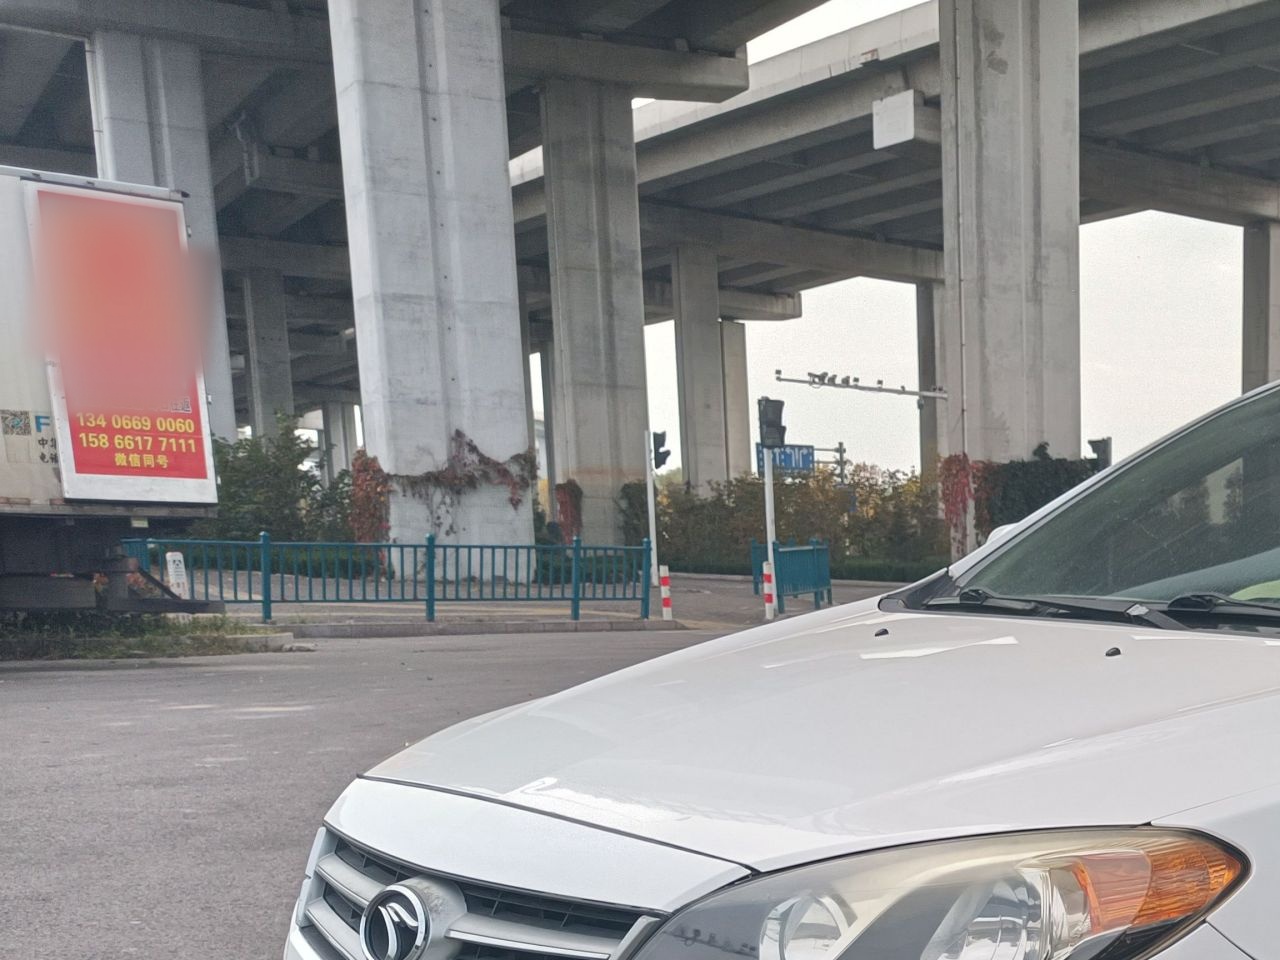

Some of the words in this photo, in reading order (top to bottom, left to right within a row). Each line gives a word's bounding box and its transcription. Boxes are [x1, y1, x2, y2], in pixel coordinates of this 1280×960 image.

[77, 413, 107, 428] 134
[112, 415, 151, 430] 0669
[157, 417, 195, 432] 0060
[80, 433, 109, 448] 158
[114, 435, 153, 450] 6617
[158, 437, 196, 453] 7111
[115, 453, 168, 468] 微信同号
